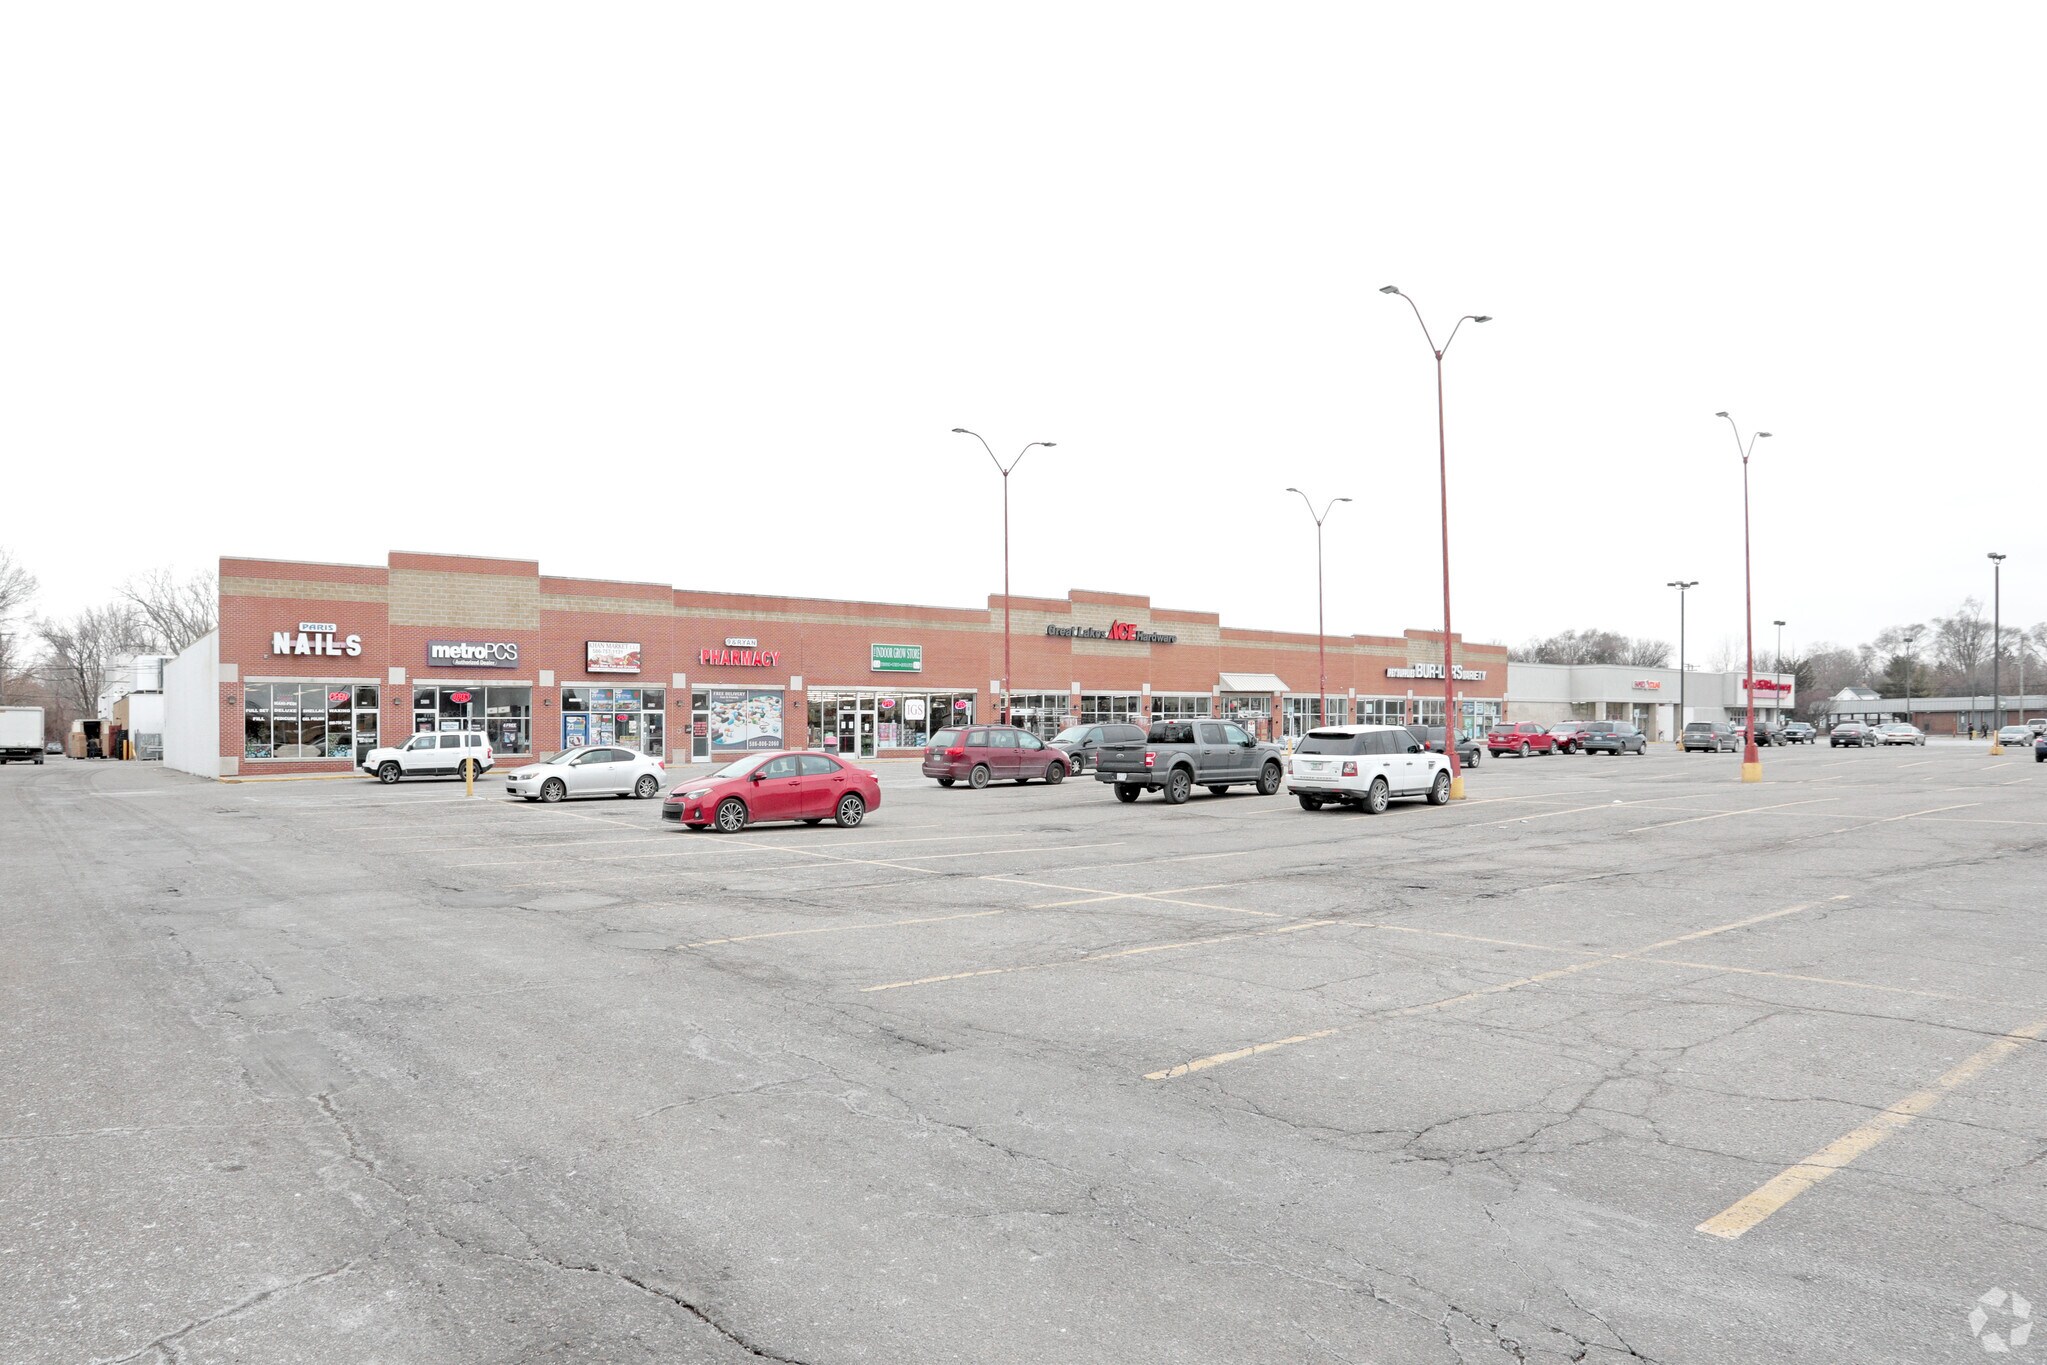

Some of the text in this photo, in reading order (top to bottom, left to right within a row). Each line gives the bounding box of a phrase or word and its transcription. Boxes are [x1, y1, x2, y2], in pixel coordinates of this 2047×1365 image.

[1046, 619, 1178, 643] Great Lakes ACE Hardware
[273, 631, 362, 656] NAILS
[431, 643, 518, 660] metroPCS
[700, 648, 781, 667] PHARMACY
[875, 646, 893, 658] INDOOR
[893, 647, 906, 659] GROW
[906, 648, 920, 660] STORE
[1415, 663, 1463, 680] BUR-LRS
[328, 692, 349, 701] OPEN
[907, 704, 924, 716] IGS
